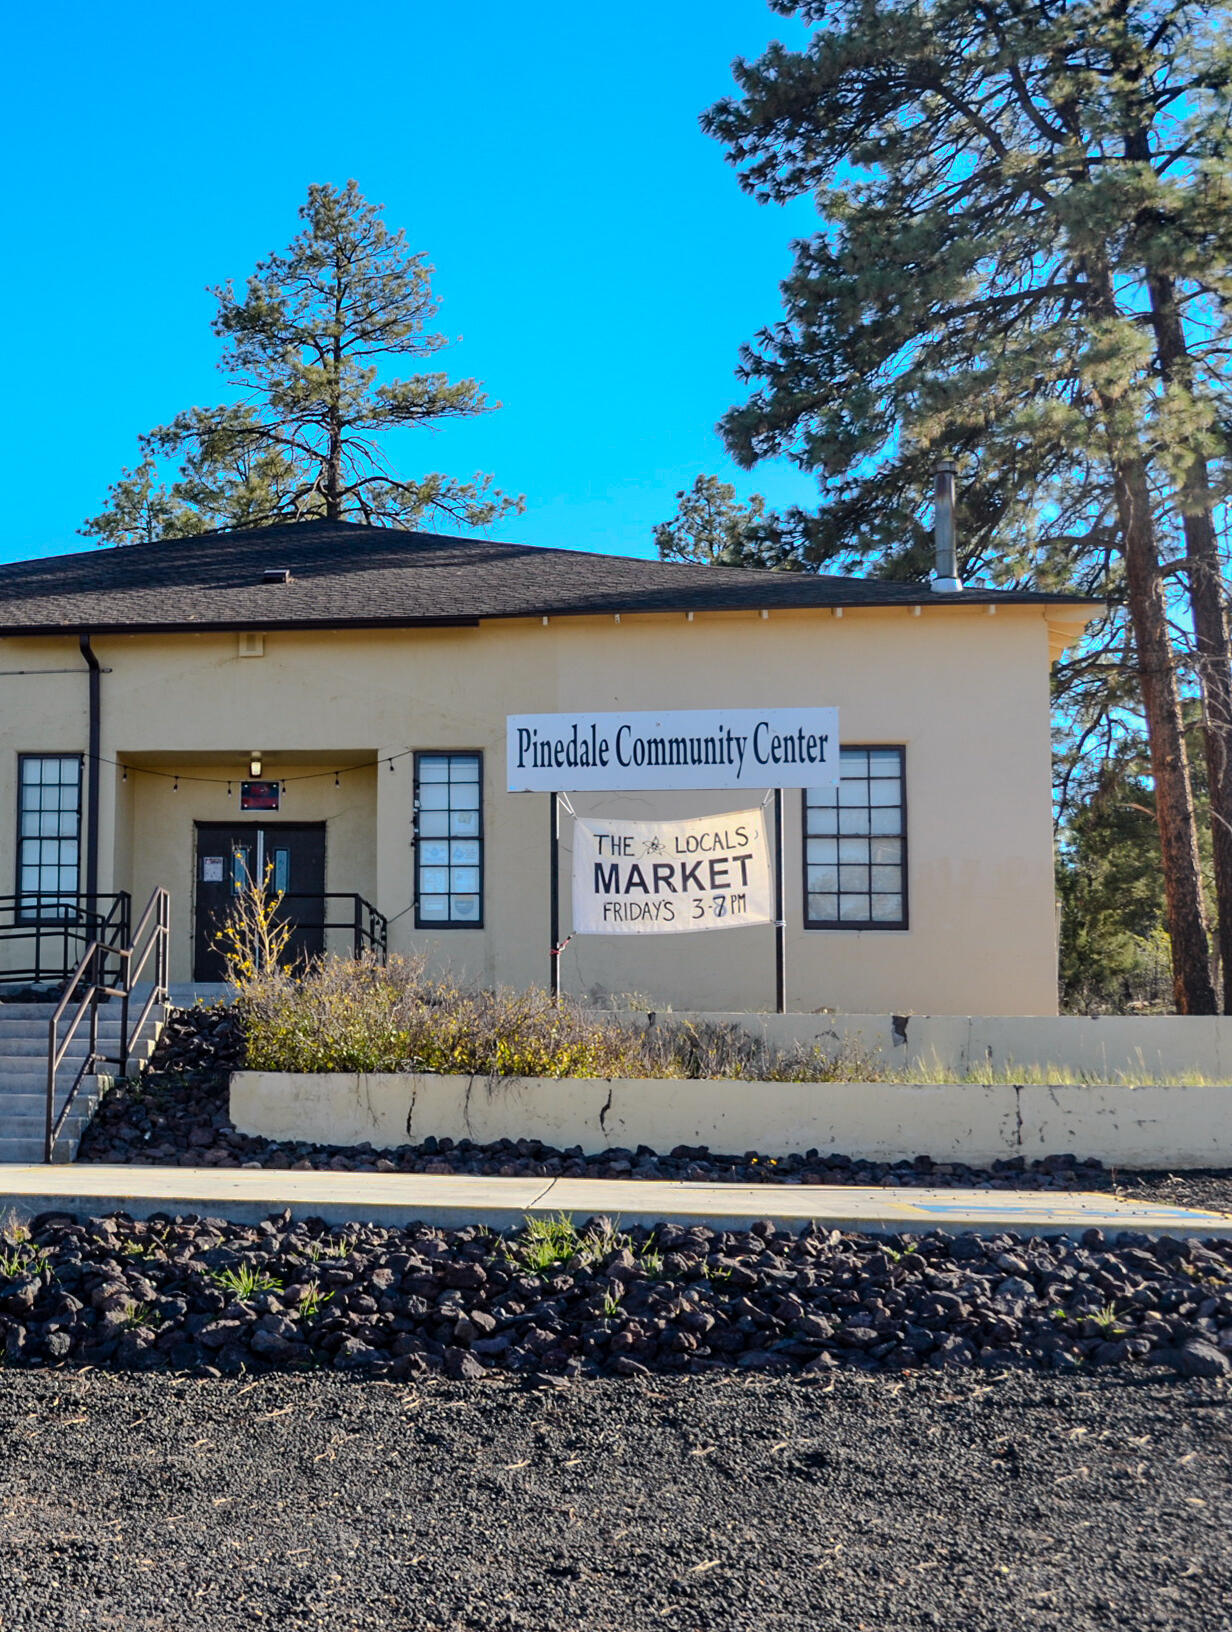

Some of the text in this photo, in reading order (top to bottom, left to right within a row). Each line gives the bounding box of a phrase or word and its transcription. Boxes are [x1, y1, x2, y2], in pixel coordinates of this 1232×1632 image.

[516, 721, 829, 779] Pinedale Community Center
[593, 826, 749, 857] THE LOCALS
[594, 853, 753, 895] MARKET
[730, 892, 747, 915] PM
